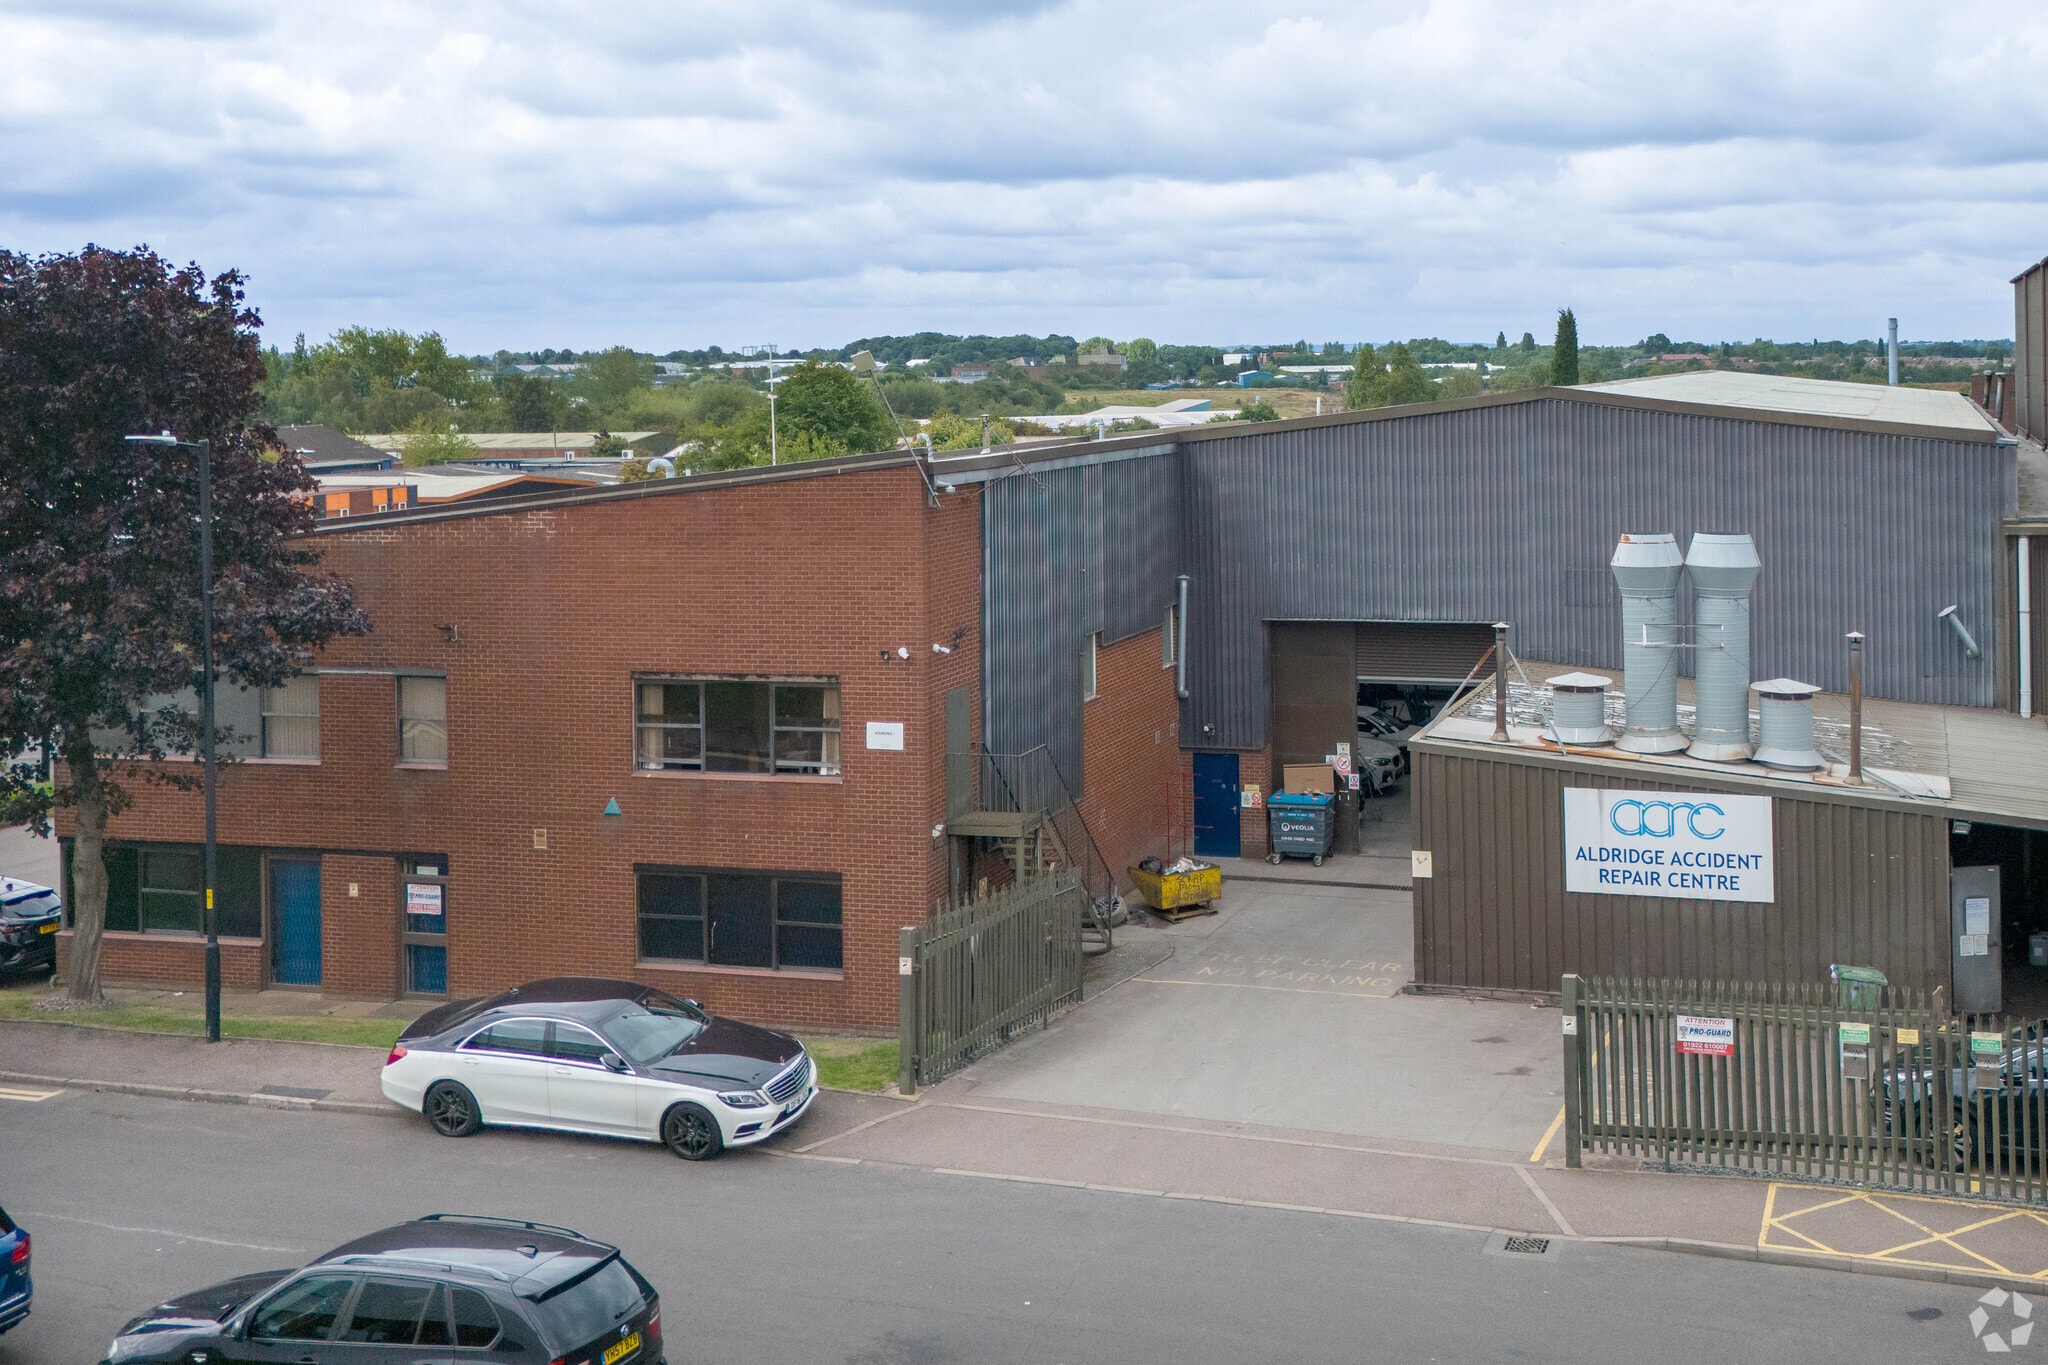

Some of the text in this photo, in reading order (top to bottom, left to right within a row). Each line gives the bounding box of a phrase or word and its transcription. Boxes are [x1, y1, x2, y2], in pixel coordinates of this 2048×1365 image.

[1575, 846, 1763, 870] ALDRIDGE ACCIDENT
[1599, 868, 1740, 891] REPAIR CENTRE
[1196, 966, 1392, 987] NO PARKING
[1685, 1017, 1726, 1026] ATTENTION
[1689, 1027, 1732, 1037] PRO-GUARD
